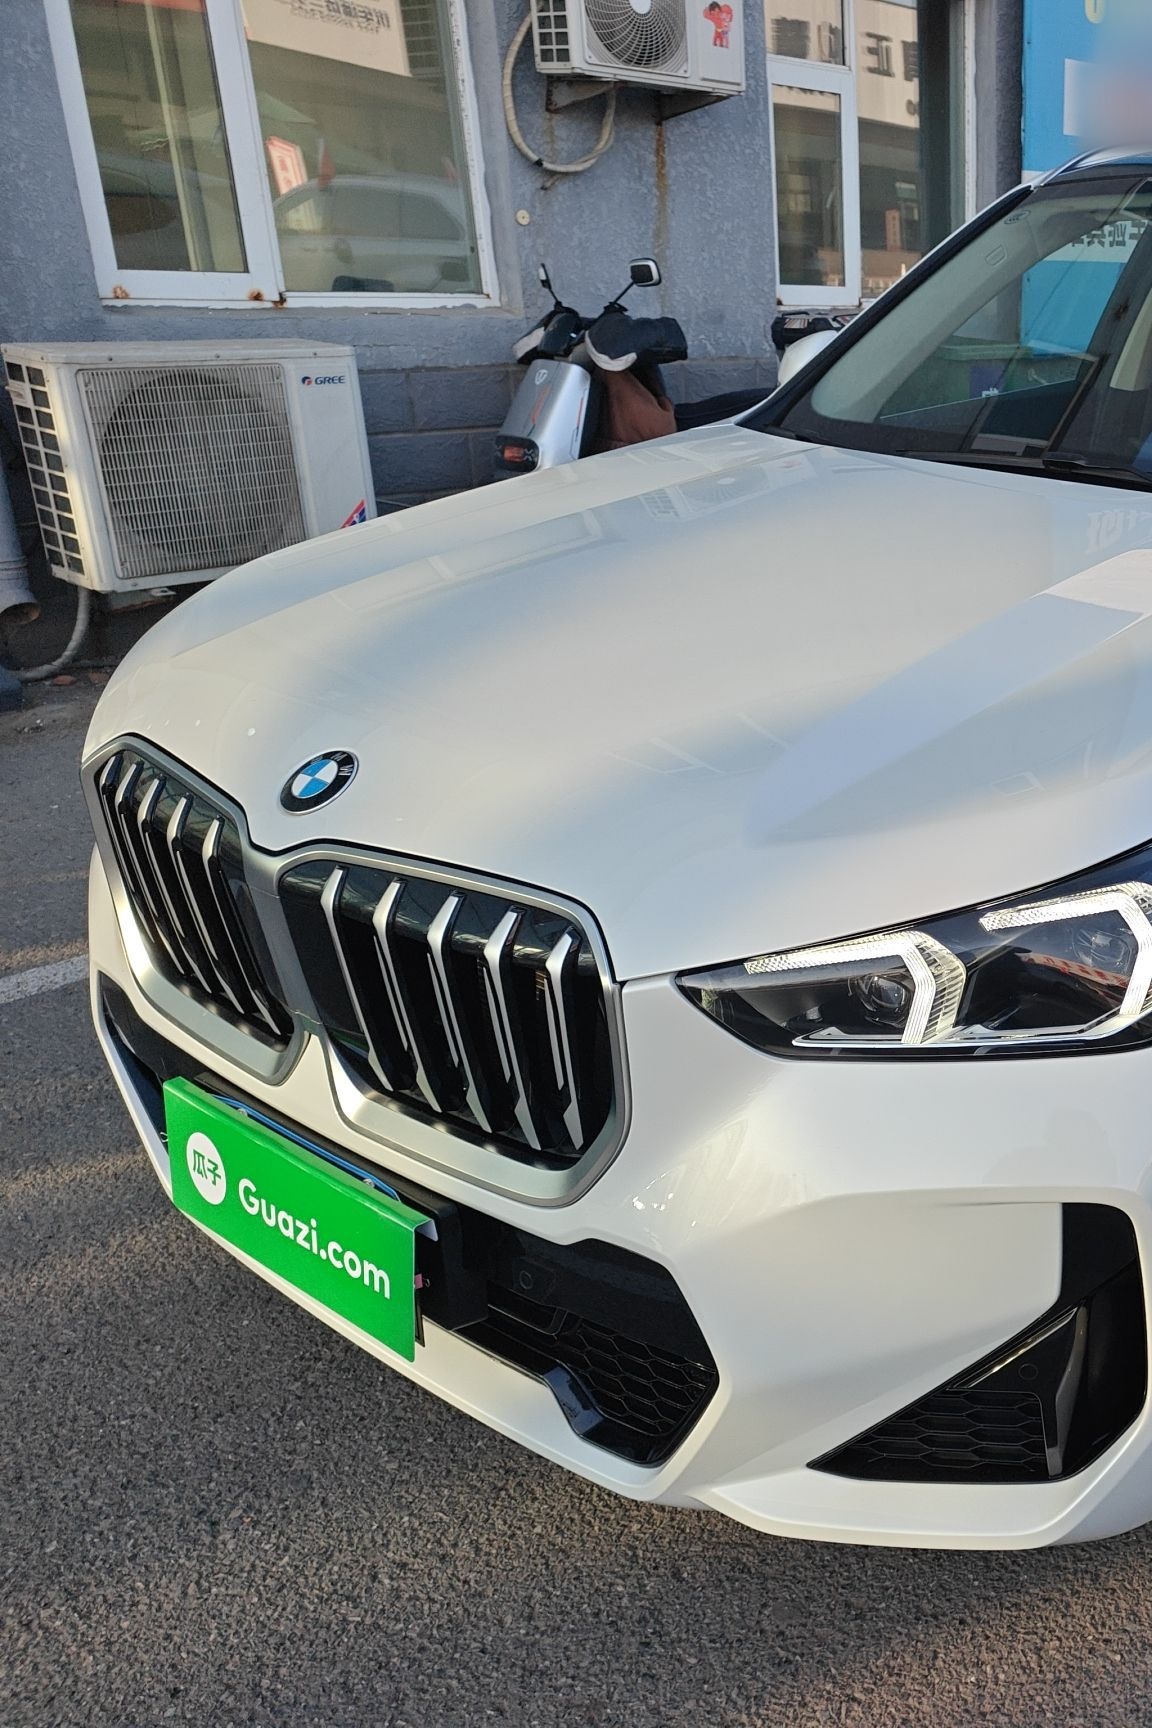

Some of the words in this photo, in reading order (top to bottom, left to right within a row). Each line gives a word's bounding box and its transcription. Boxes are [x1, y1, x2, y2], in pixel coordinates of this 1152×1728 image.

[314, 375, 345, 385] GREE
[192, 1149, 221, 1186] 瓜子
[238, 1178, 390, 1300] Guazi.com
